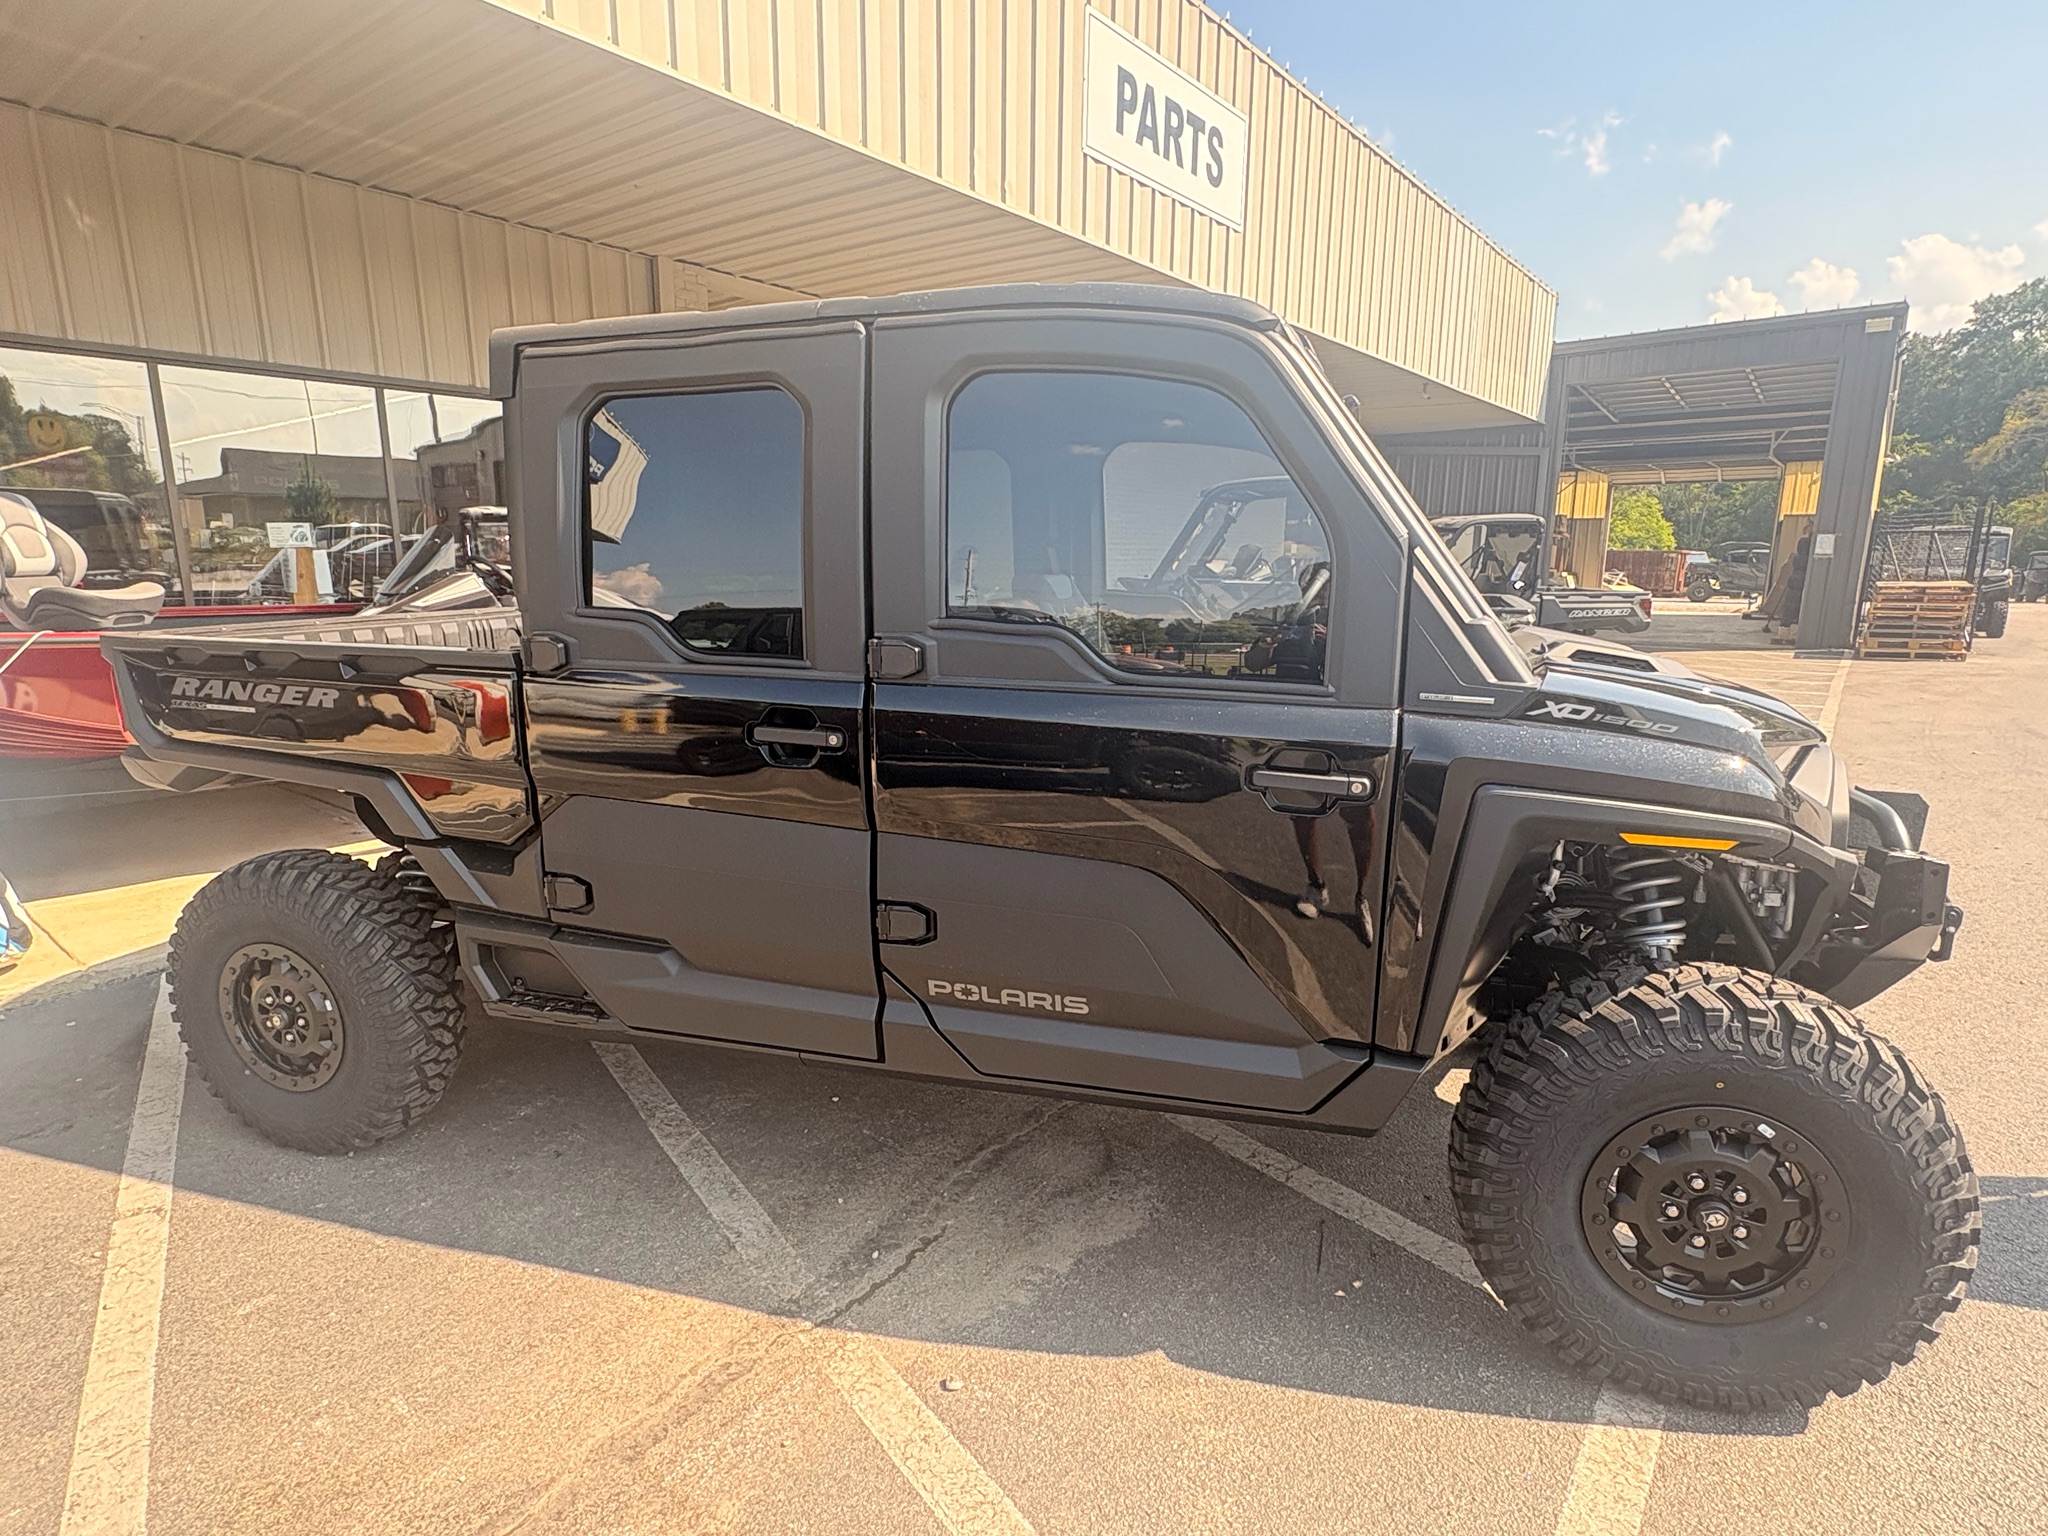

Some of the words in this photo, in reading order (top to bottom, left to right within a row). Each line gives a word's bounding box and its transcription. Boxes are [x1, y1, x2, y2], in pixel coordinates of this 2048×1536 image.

[1116, 64, 1224, 188] PARTS
[1568, 608, 1632, 618] RANGER
[171, 677, 340, 709] RANGER
[927, 979, 1090, 1015] POLARIS
